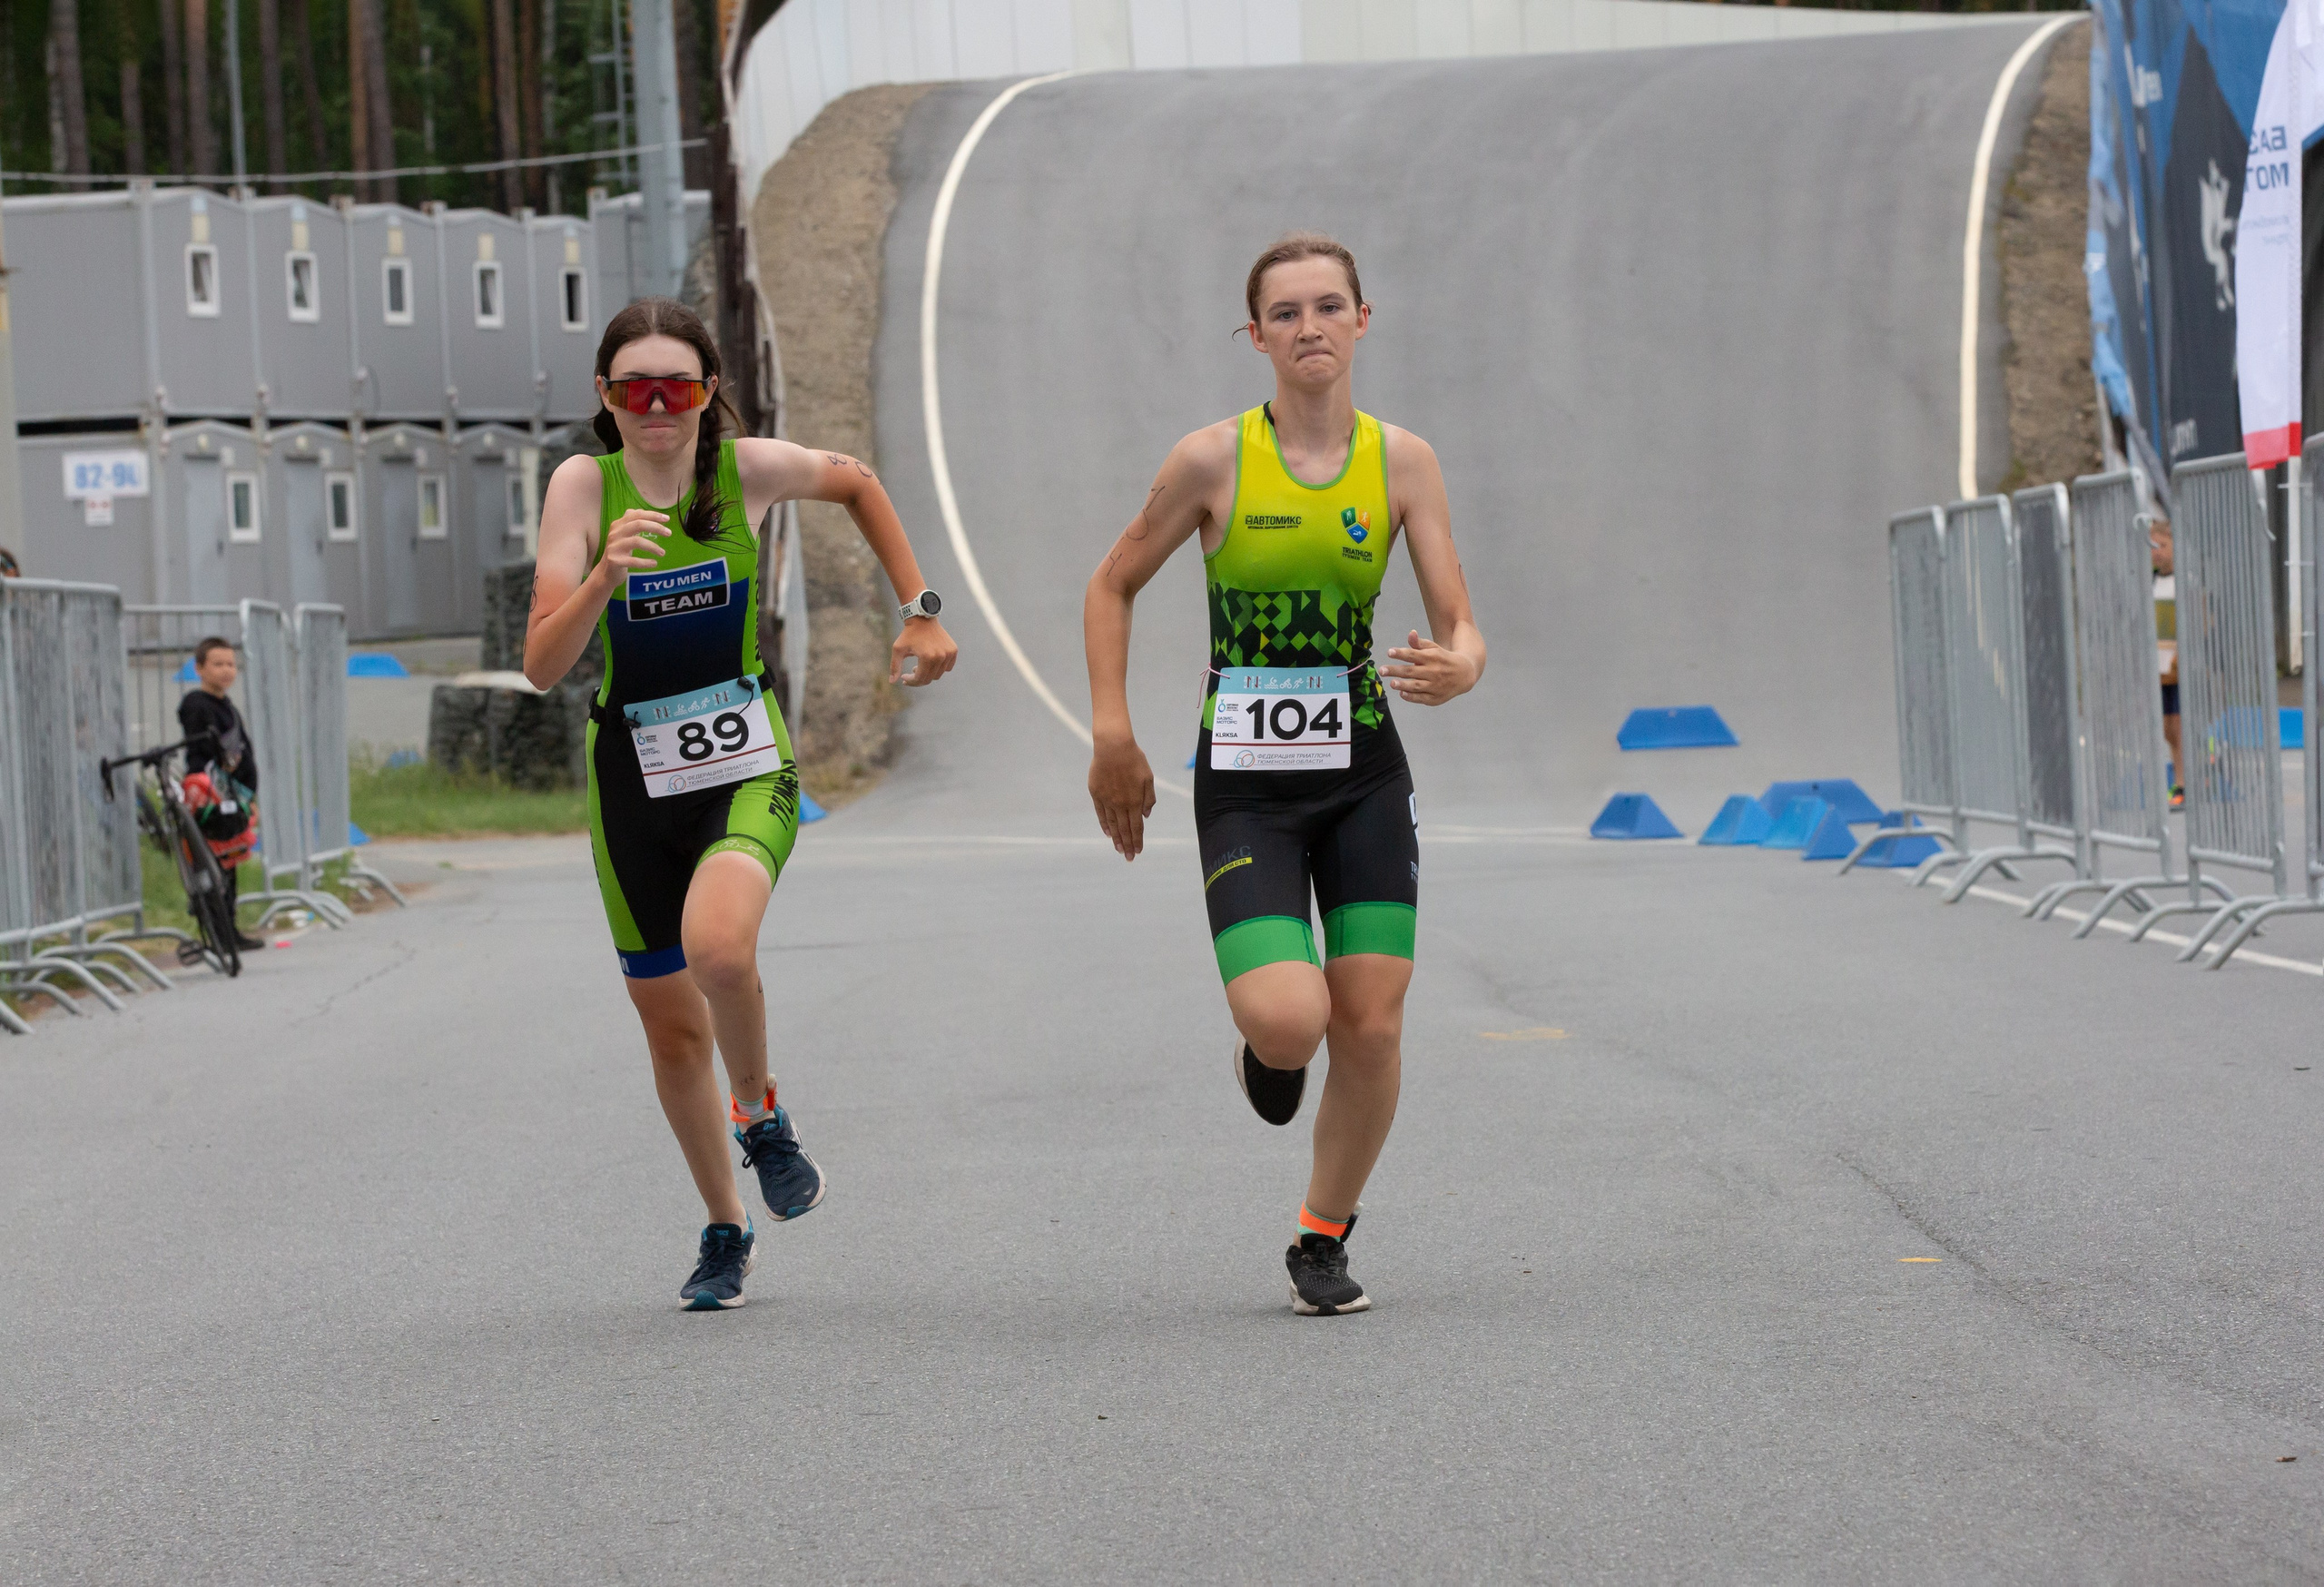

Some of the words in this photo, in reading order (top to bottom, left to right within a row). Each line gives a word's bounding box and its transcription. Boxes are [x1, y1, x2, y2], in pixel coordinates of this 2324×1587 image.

[1253, 516, 1302, 525] АВТОМИКС
[1342, 547, 1373, 558] TRIATHLON
[642, 570, 713, 593] TYUMEN
[644, 590, 714, 615] TEAM
[1246, 698, 1343, 741] 104
[677, 712, 750, 762] 89
[686, 768, 724, 781] ФЕДЕРАЦИЯ
[724, 759, 760, 774] ТРИАТЛОНА
[688, 774, 725, 786] ТЮМЕНСКОЙ
[725, 767, 753, 779] ОБЛАСТИ
